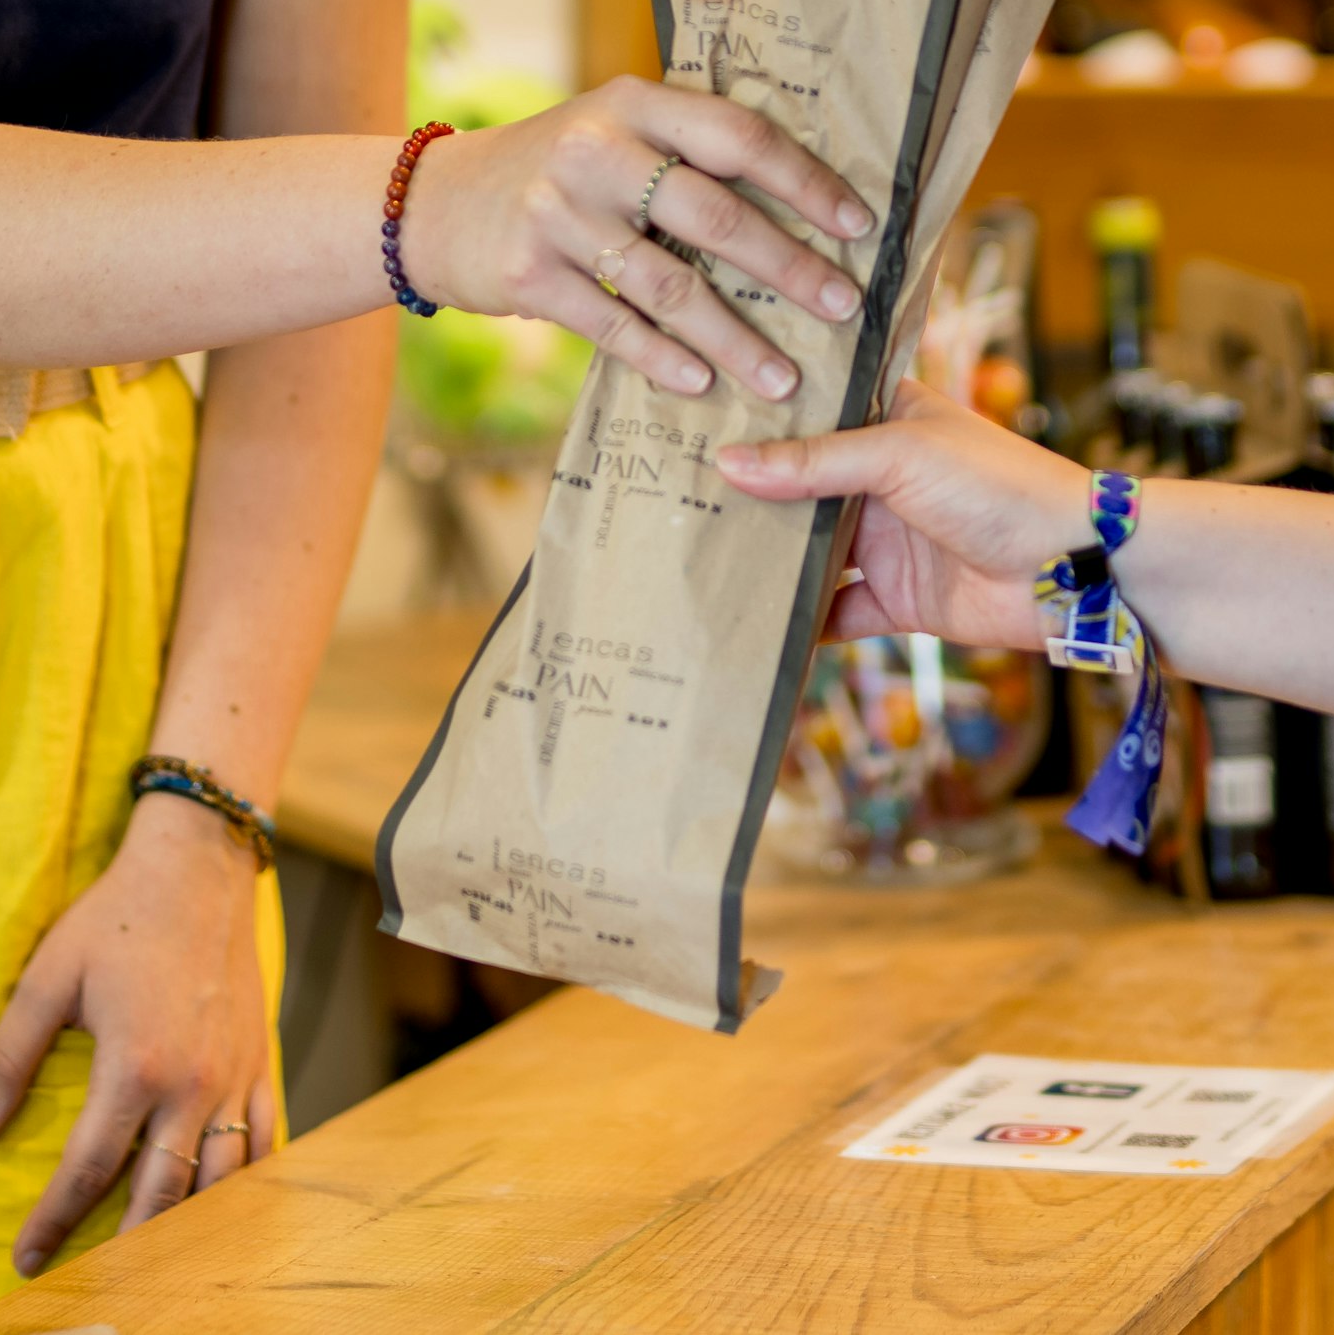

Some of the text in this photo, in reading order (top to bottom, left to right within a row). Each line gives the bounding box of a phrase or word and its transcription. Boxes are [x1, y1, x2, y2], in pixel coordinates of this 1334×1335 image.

[698, 30, 764, 65] PAIN
[610, 417, 708, 449] encas
[591, 450, 665, 482] PAIN
[554, 631, 655, 664] encas
[535, 662, 614, 701] PAIN
[509, 847, 607, 886] encas
[508, 877, 573, 920] PAIN
